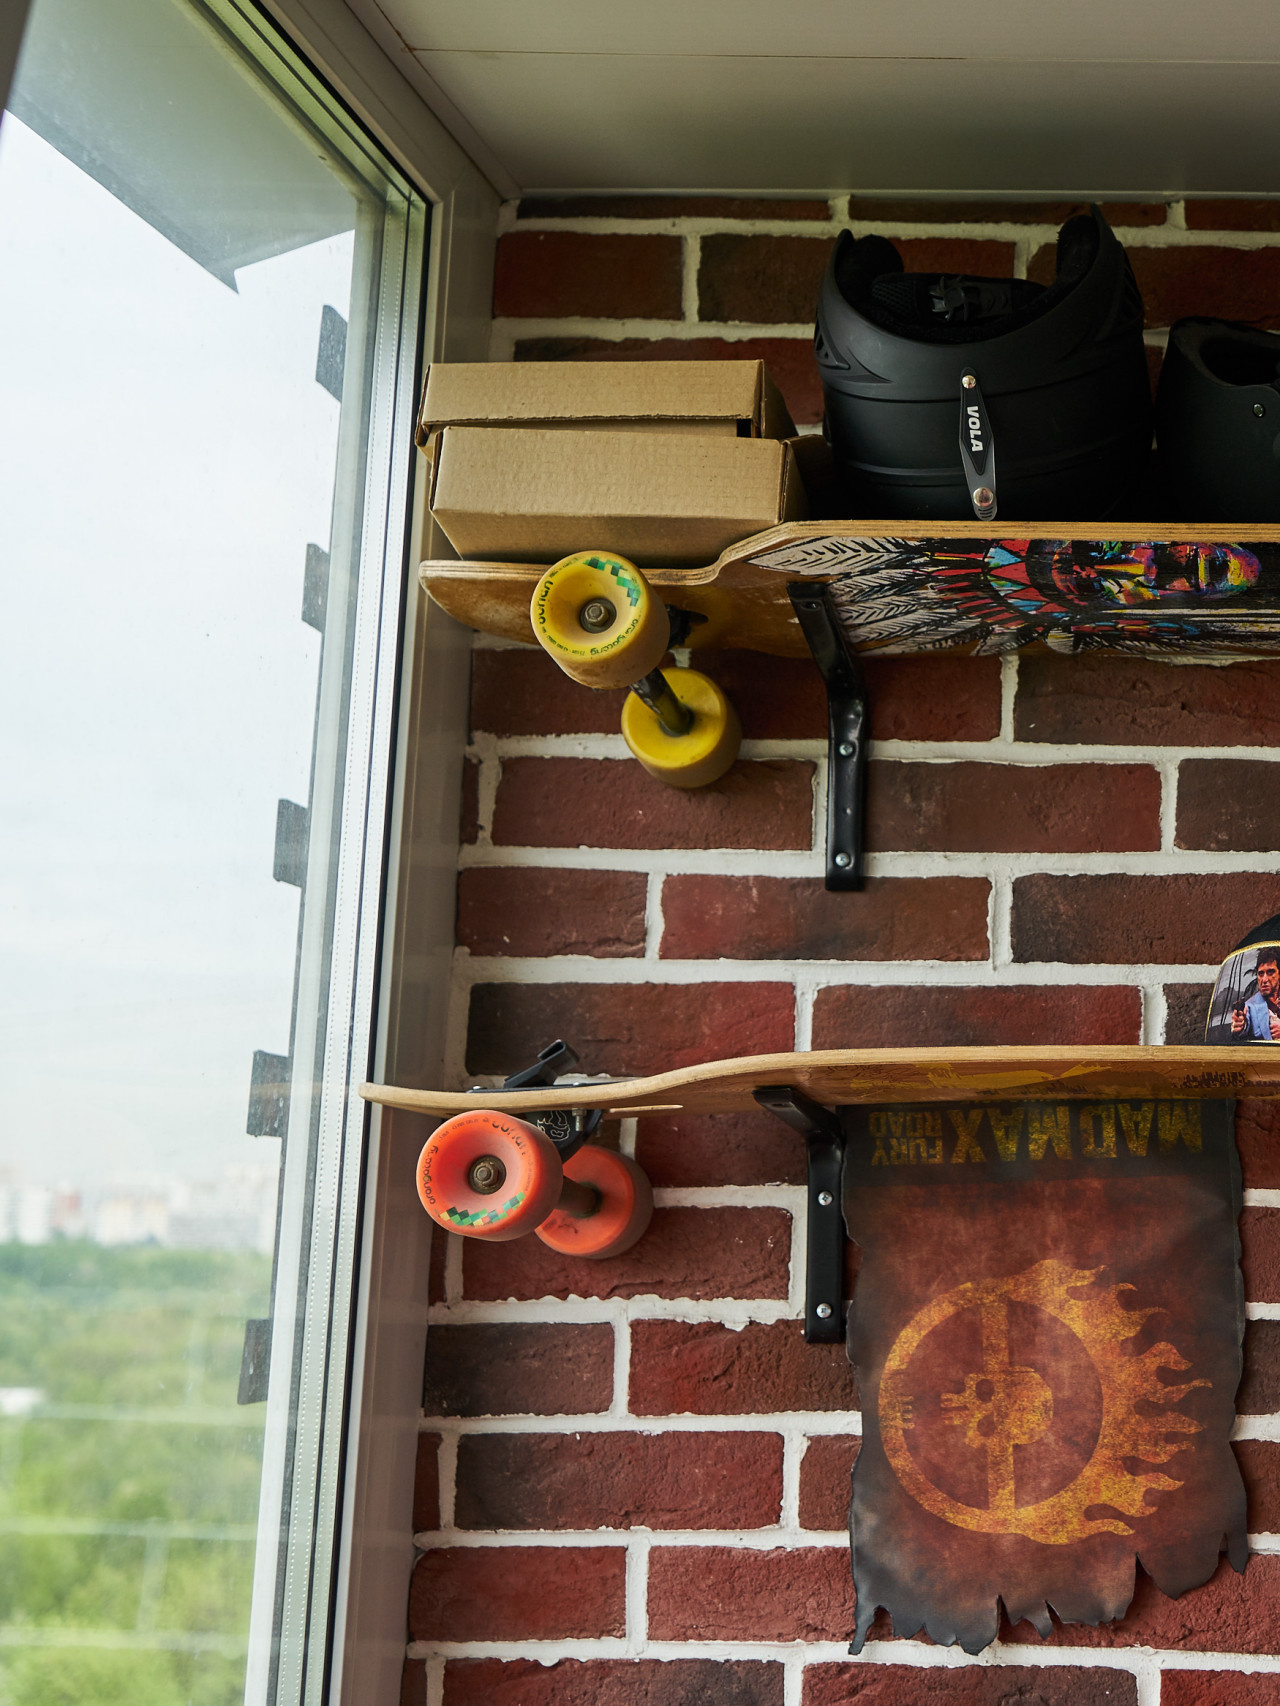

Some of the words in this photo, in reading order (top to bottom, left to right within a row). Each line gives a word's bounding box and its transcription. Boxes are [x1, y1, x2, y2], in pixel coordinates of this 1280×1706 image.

[966, 405, 984, 452] VOLA
[590, 618, 639, 656] oragatang
[868, 1110, 943, 1138] ROAD
[948, 1104, 1073, 1165] MAX
[1080, 1101, 1203, 1159] MAD
[870, 1138, 944, 1167] FURY
